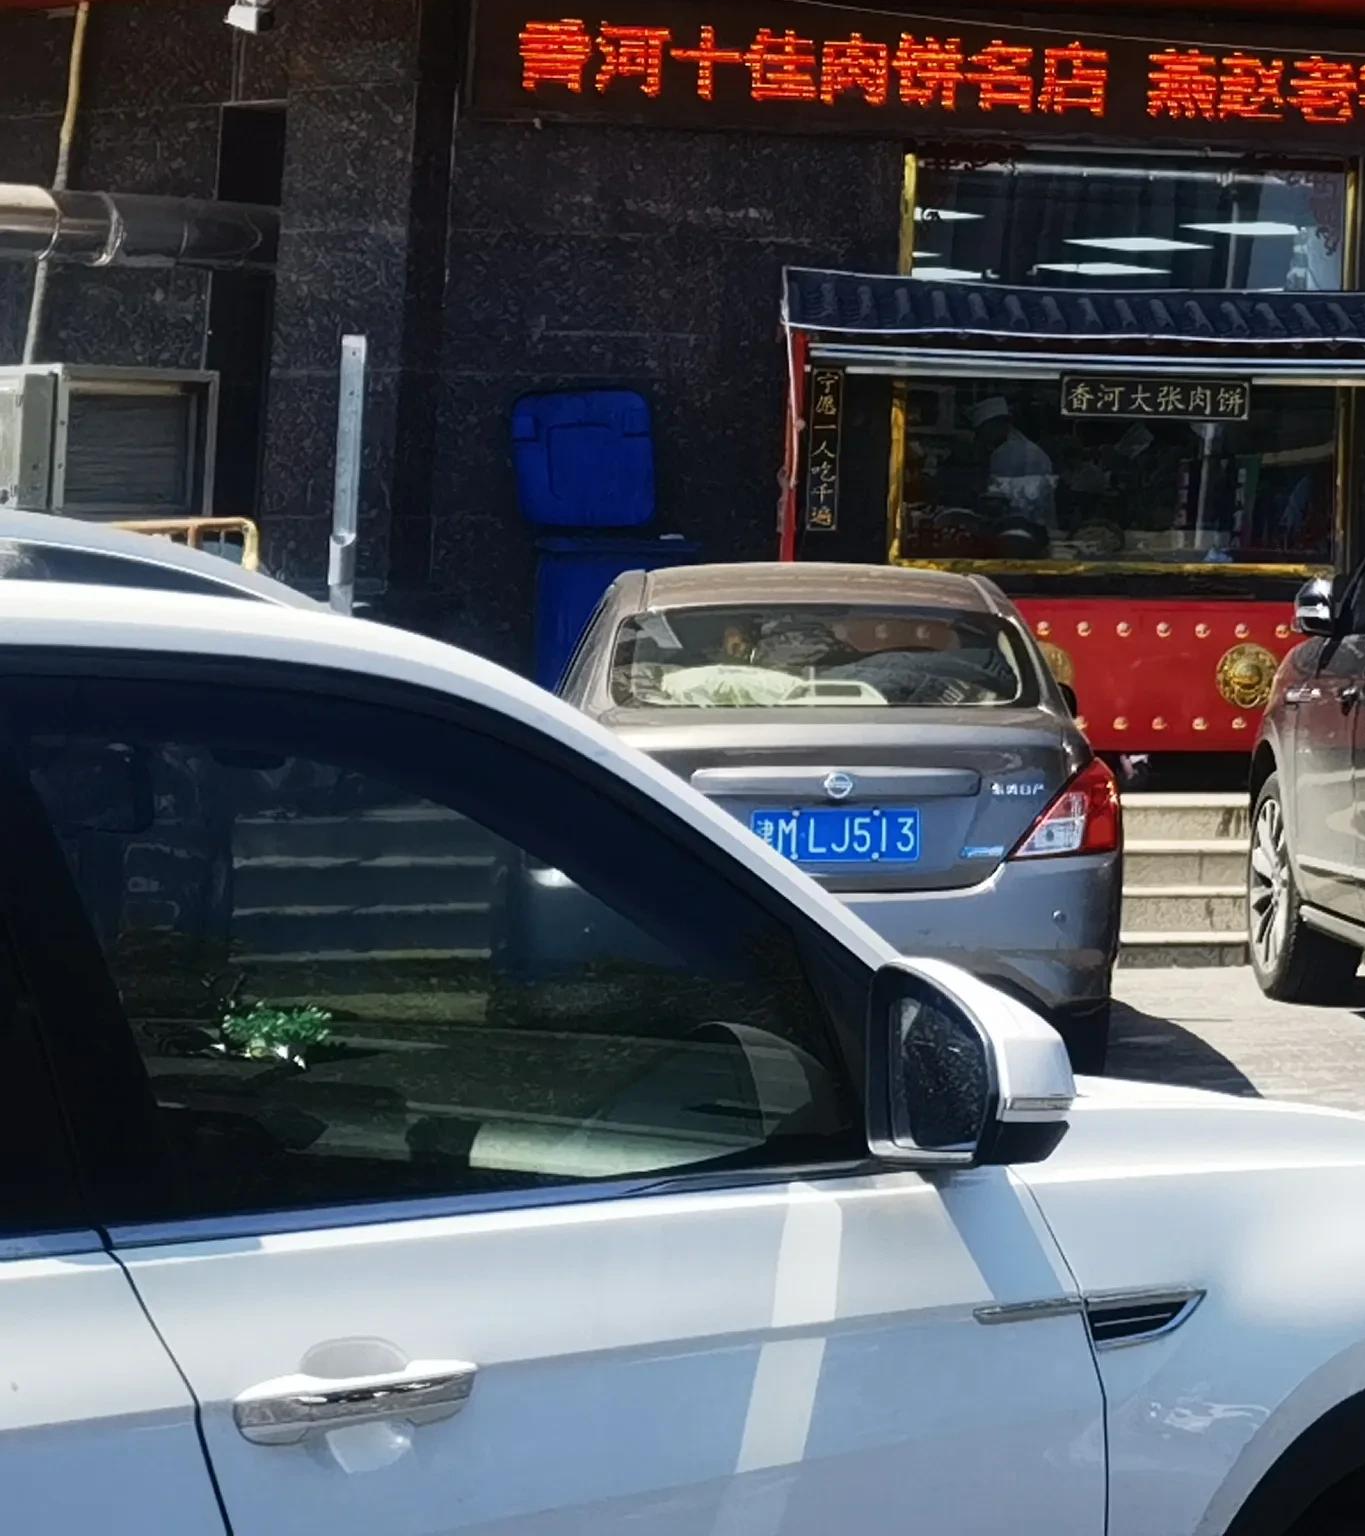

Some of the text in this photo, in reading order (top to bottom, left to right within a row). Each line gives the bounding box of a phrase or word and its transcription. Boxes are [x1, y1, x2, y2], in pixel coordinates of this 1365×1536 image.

[518, 18, 1108, 118] 香河十佳肉饼名店
[1067, 382, 1245, 415] 香河大张肉饼
[810, 373, 839, 527] 宁愿一人吃千遍
